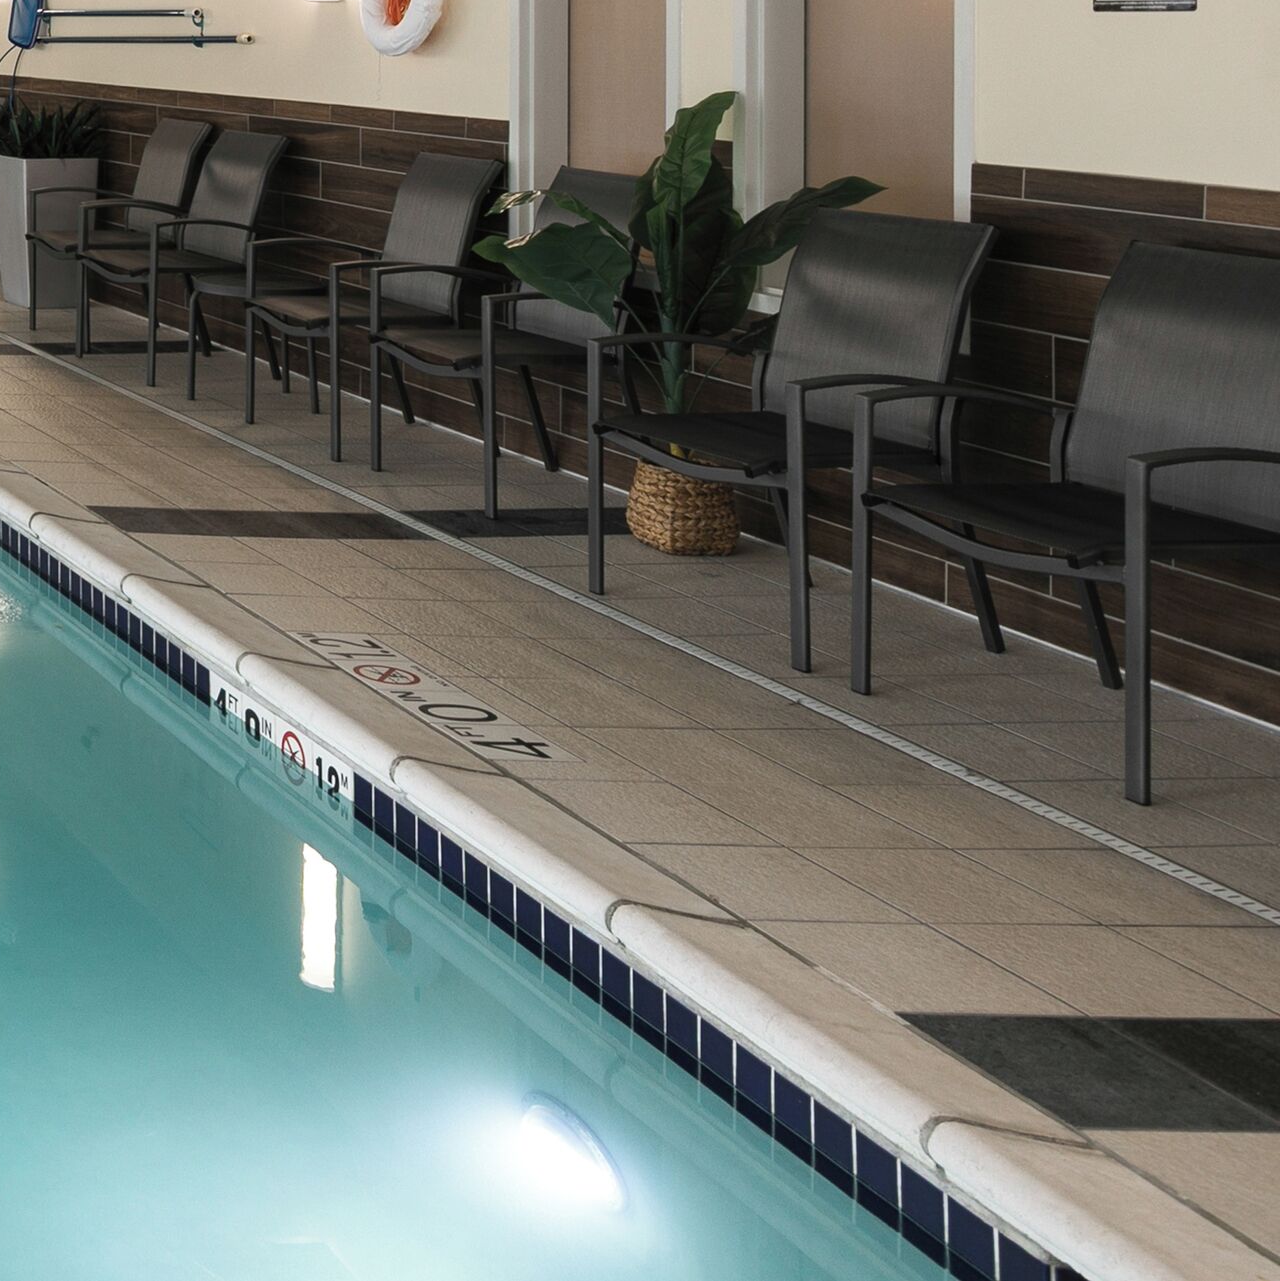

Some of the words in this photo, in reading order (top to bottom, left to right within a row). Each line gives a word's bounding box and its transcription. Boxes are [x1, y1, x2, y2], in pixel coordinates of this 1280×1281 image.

[390, 690, 427, 703] IN
[418, 704, 498, 723] 0
[214, 687, 228, 717] 4
[228, 694, 239, 713] FT
[261, 719, 272, 739] IN
[340, 773, 349, 790] M
[443, 724, 484, 739] FT
[471, 737, 553, 759] 4
